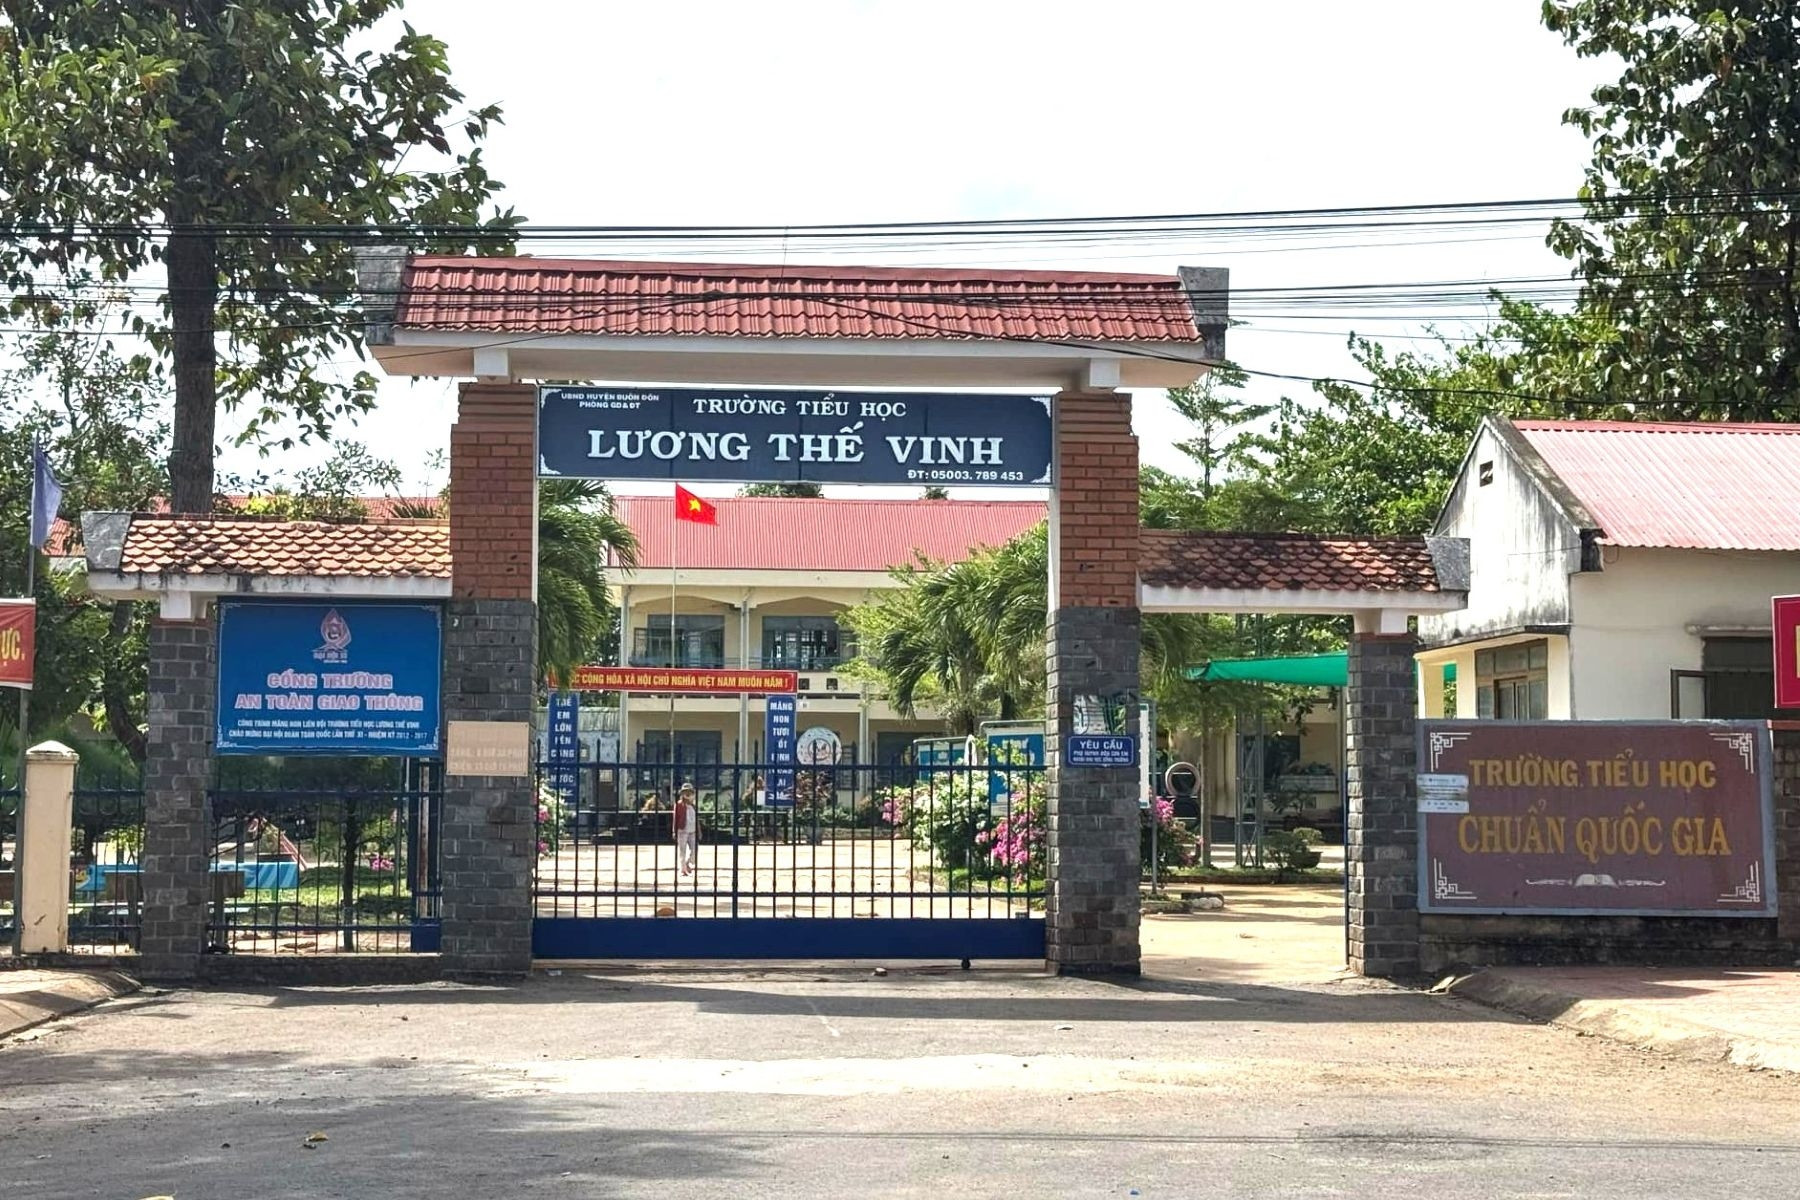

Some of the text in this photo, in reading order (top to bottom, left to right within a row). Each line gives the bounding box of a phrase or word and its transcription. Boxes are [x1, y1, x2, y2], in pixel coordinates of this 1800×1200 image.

[561, 392, 585, 400] UBND
[693, 393, 907, 422] TRƯỜNG TIỂU HỌC
[587, 421, 1004, 465] LƯƠNG THẾ VINH
[907, 469, 1024, 481] ĐT: 05003. 789 453
[582, 673, 604, 685] CỘNG
[653, 672, 670, 686] CHỦ
[698, 675, 716, 689] VIỆT
[717, 676, 737, 687] NAM
[763, 676, 783, 688] NĂM
[234, 692, 424, 711] AN TOÀN GIAO THÔNG
[770, 702, 793, 711] MĂNG
[557, 711, 570, 719] EM
[773, 715, 790, 723] NON
[1080, 739, 1123, 750] YÊU CẦU
[1469, 748, 1717, 793] TRƯỜNG TIỂU HỌC
[1458, 799, 1732, 864] CHUẨN QUỐC GIA
